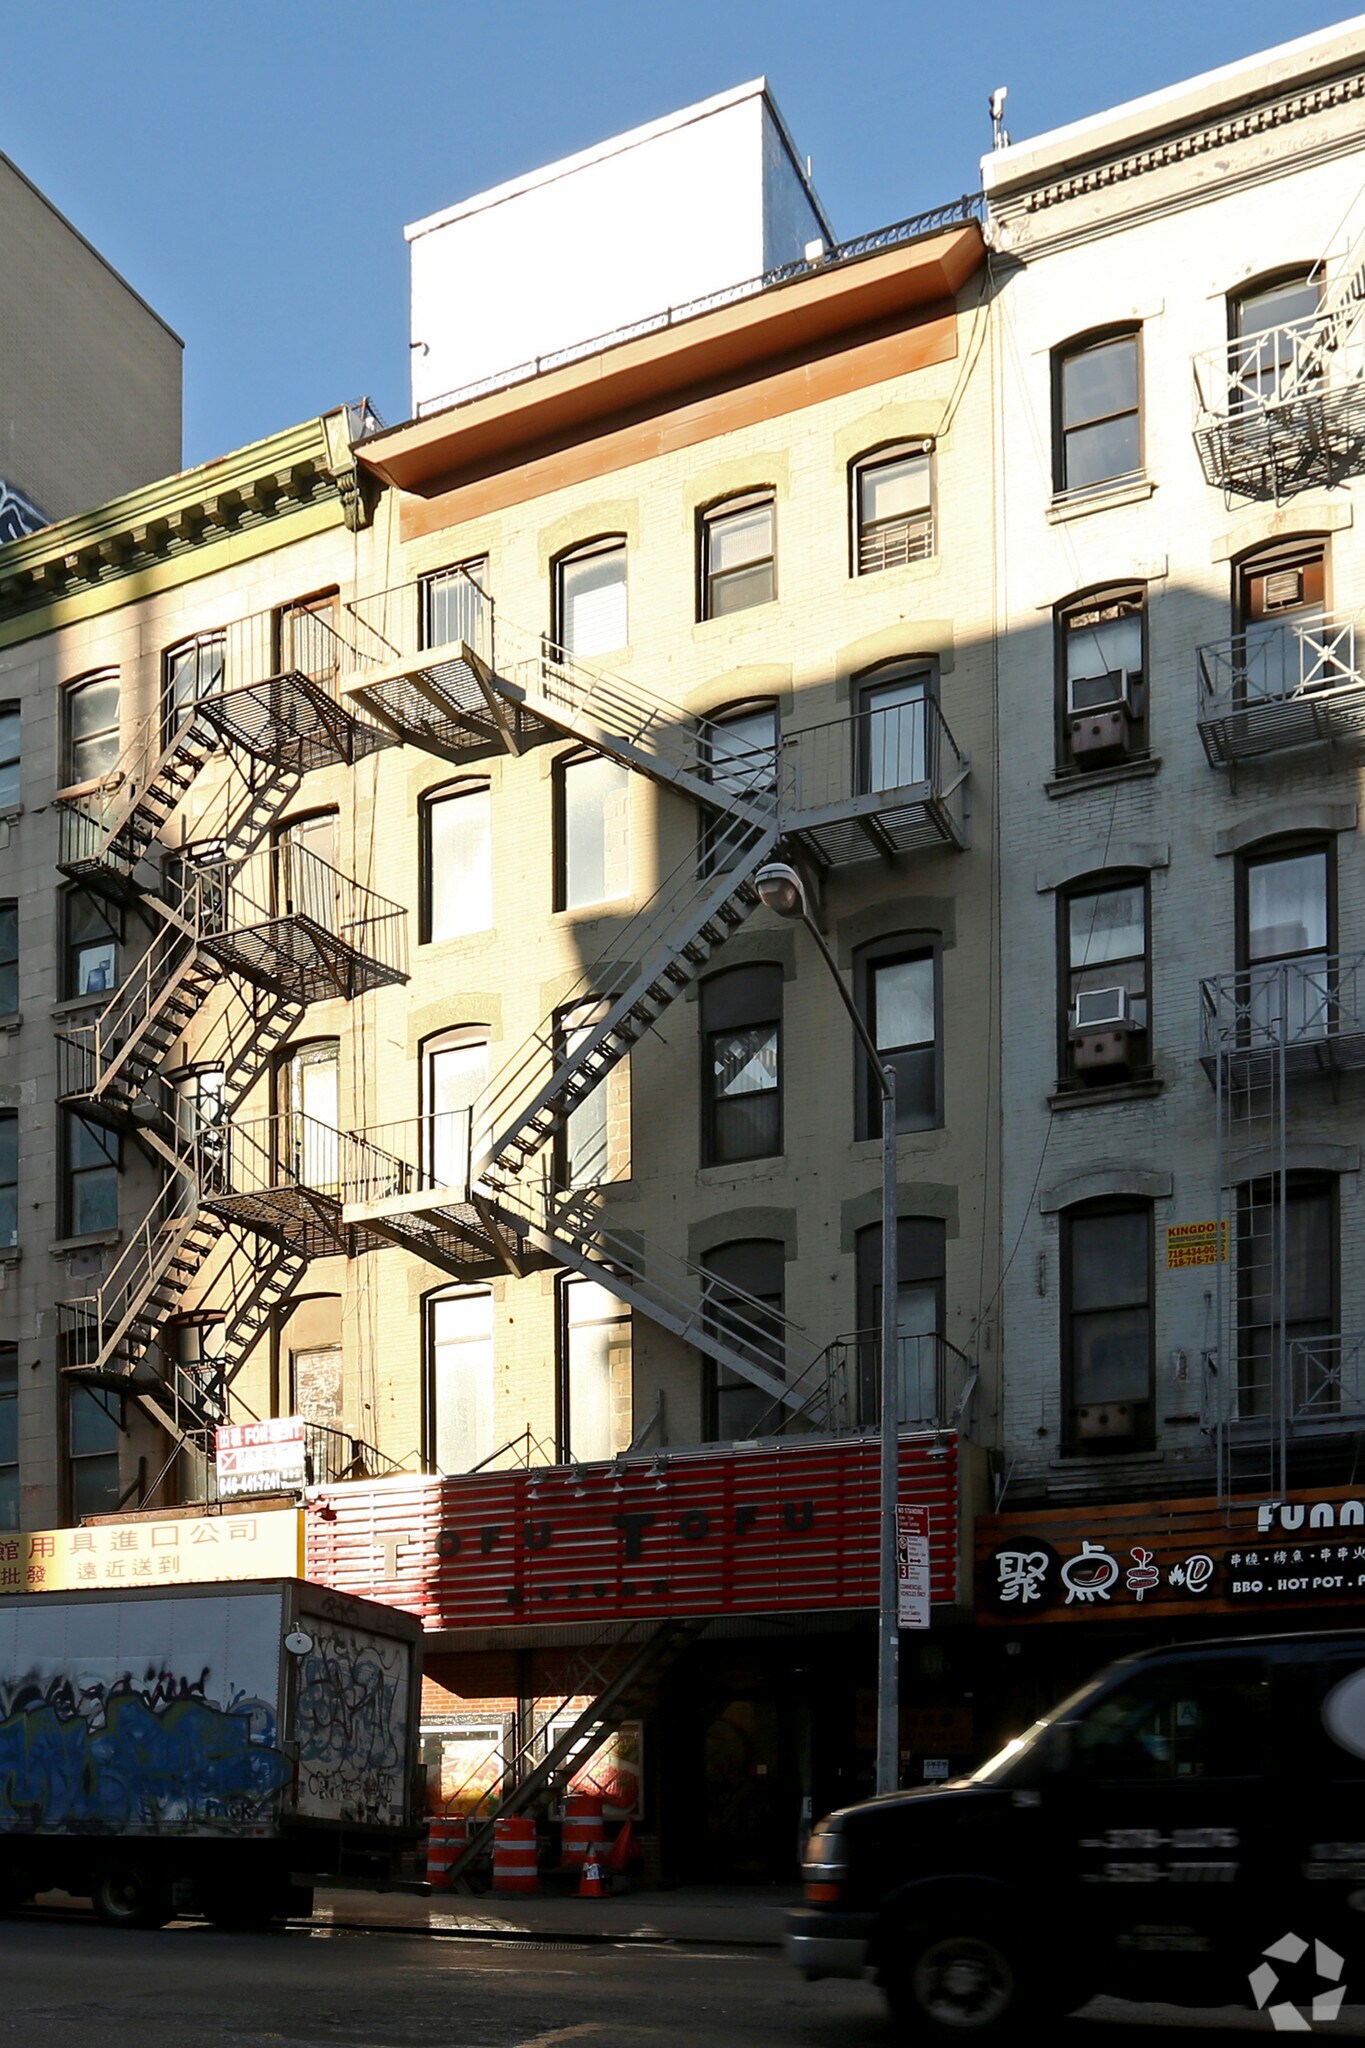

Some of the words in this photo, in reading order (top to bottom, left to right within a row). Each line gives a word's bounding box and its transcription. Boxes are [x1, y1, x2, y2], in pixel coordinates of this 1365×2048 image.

[245, 1424, 269, 1445] FOR
[372, 1521, 550, 1578] TOFU
[612, 1501, 814, 1561] TOFU
[1232, 1580, 1264, 1593] BBQ
[1277, 1577, 1309, 1590] HOT
[1312, 1576, 1344, 1588] POT
